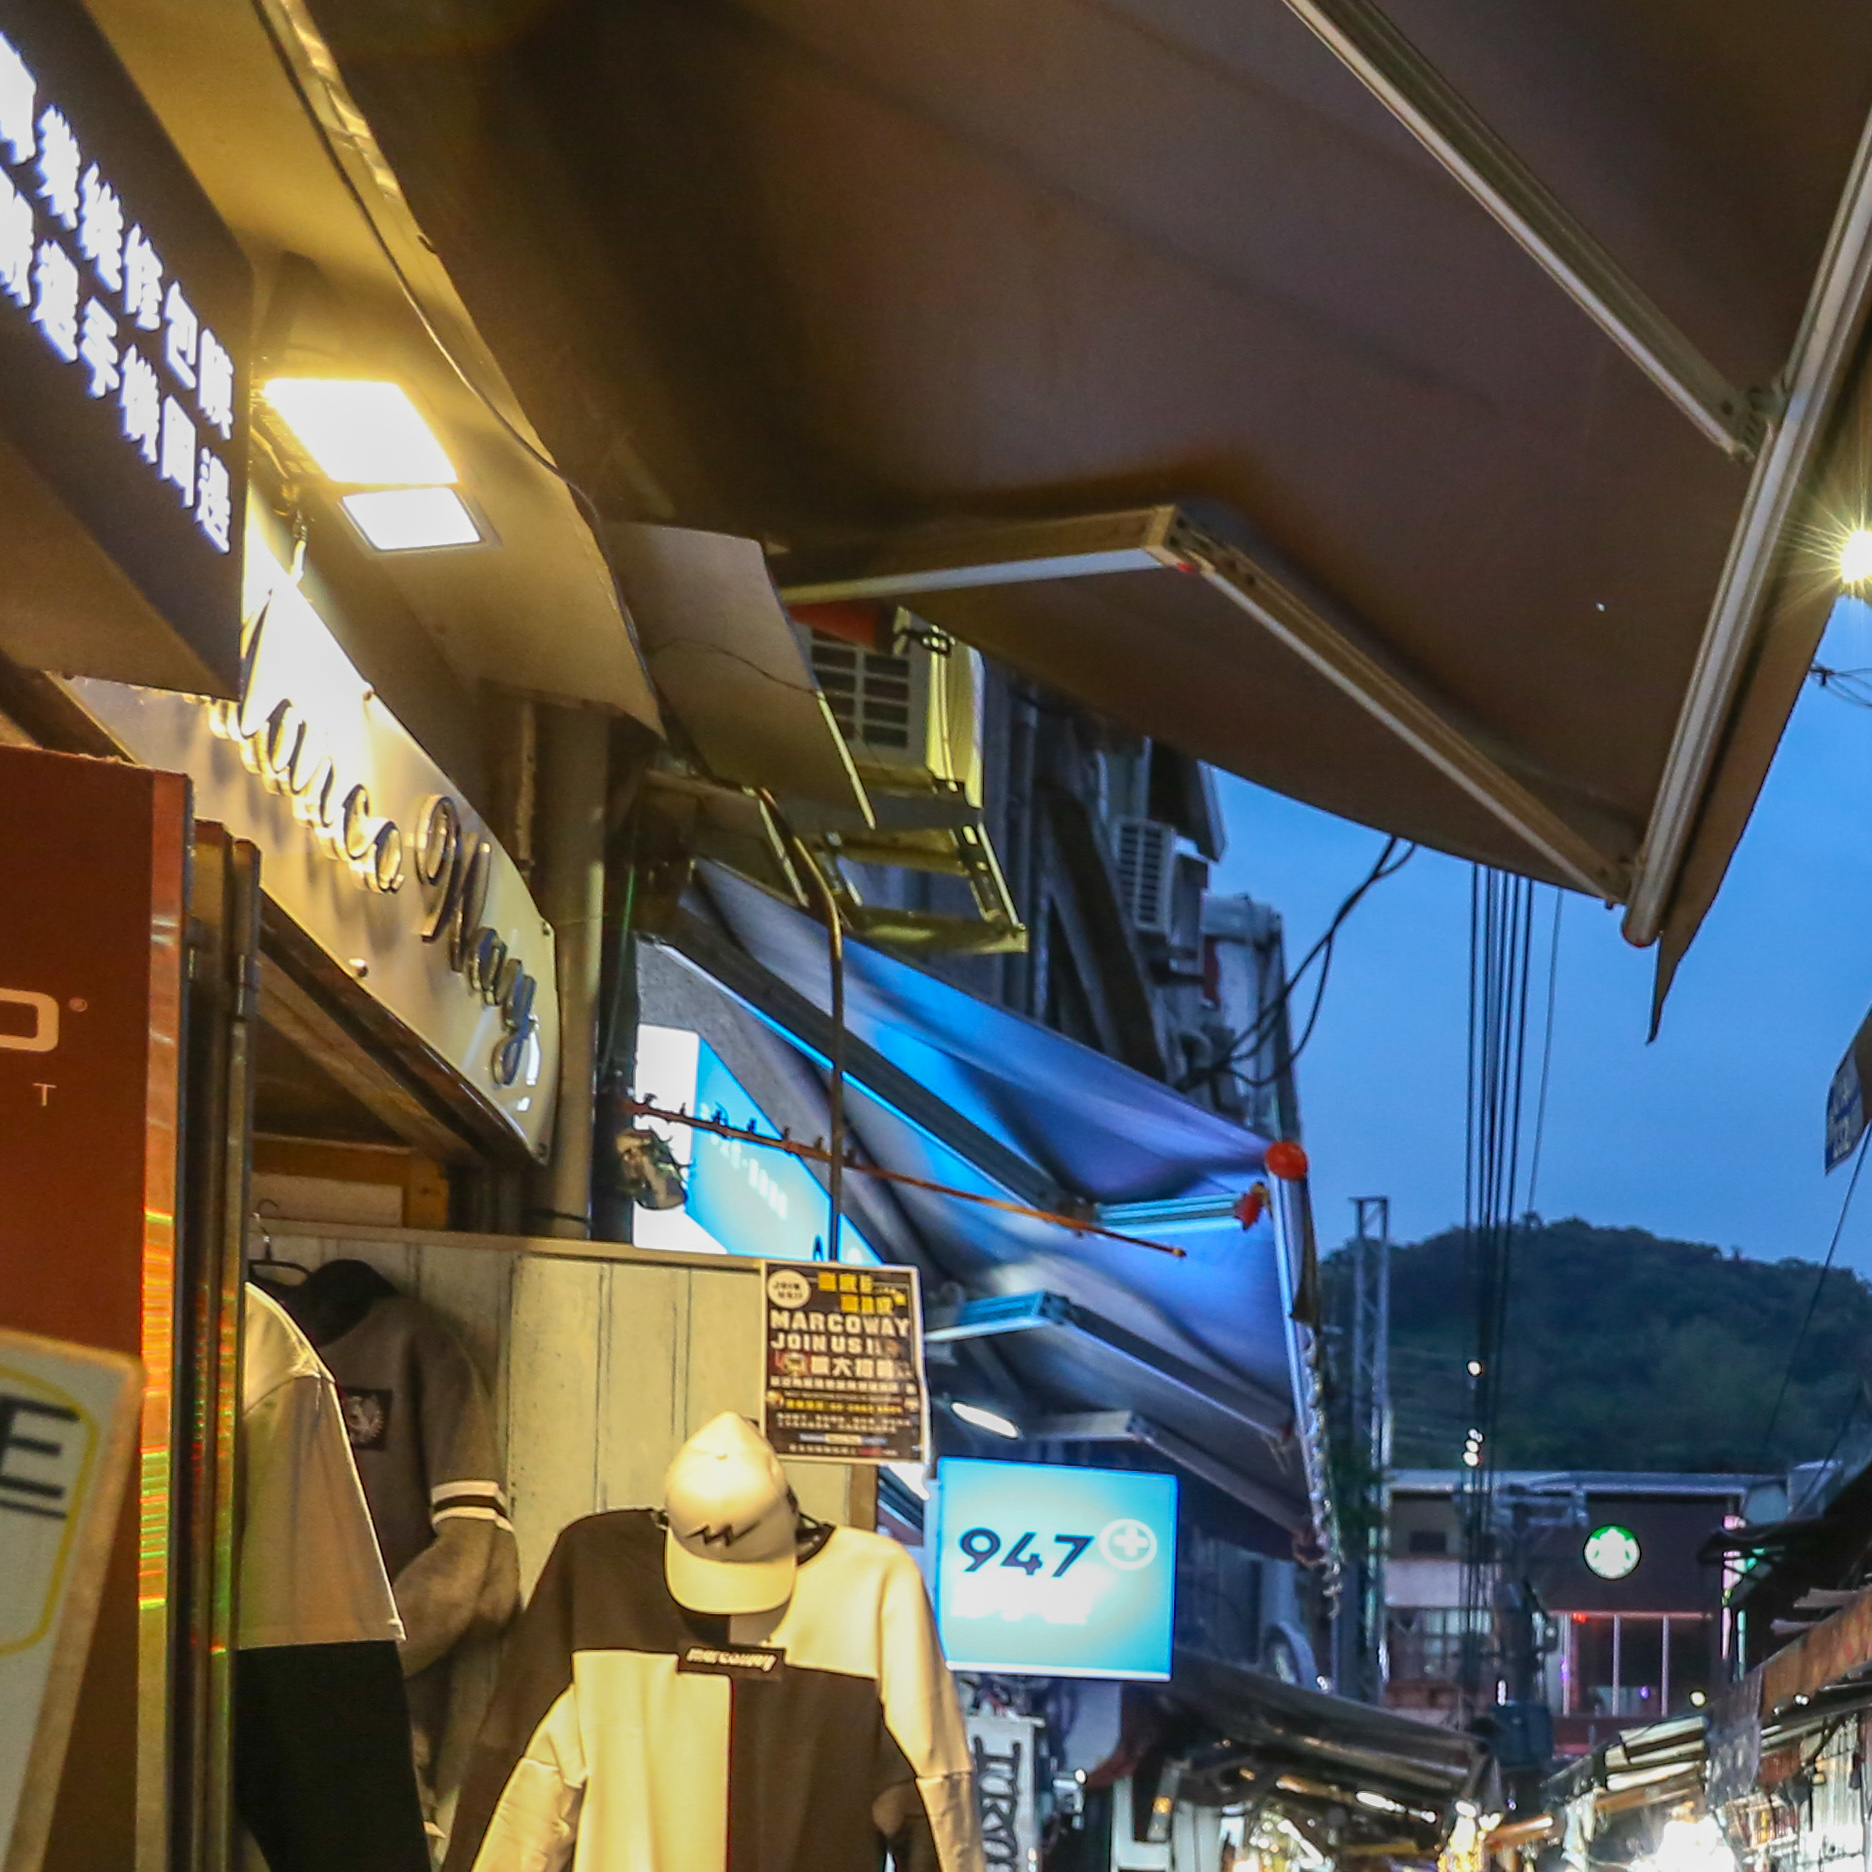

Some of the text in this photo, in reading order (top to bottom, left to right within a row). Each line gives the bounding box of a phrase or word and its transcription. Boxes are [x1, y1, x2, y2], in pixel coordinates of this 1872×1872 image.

[770, 1310, 911, 1338] MARCOWAY
[771, 1334, 828, 1352] JOIN
[960, 1527, 1095, 1578] 947
